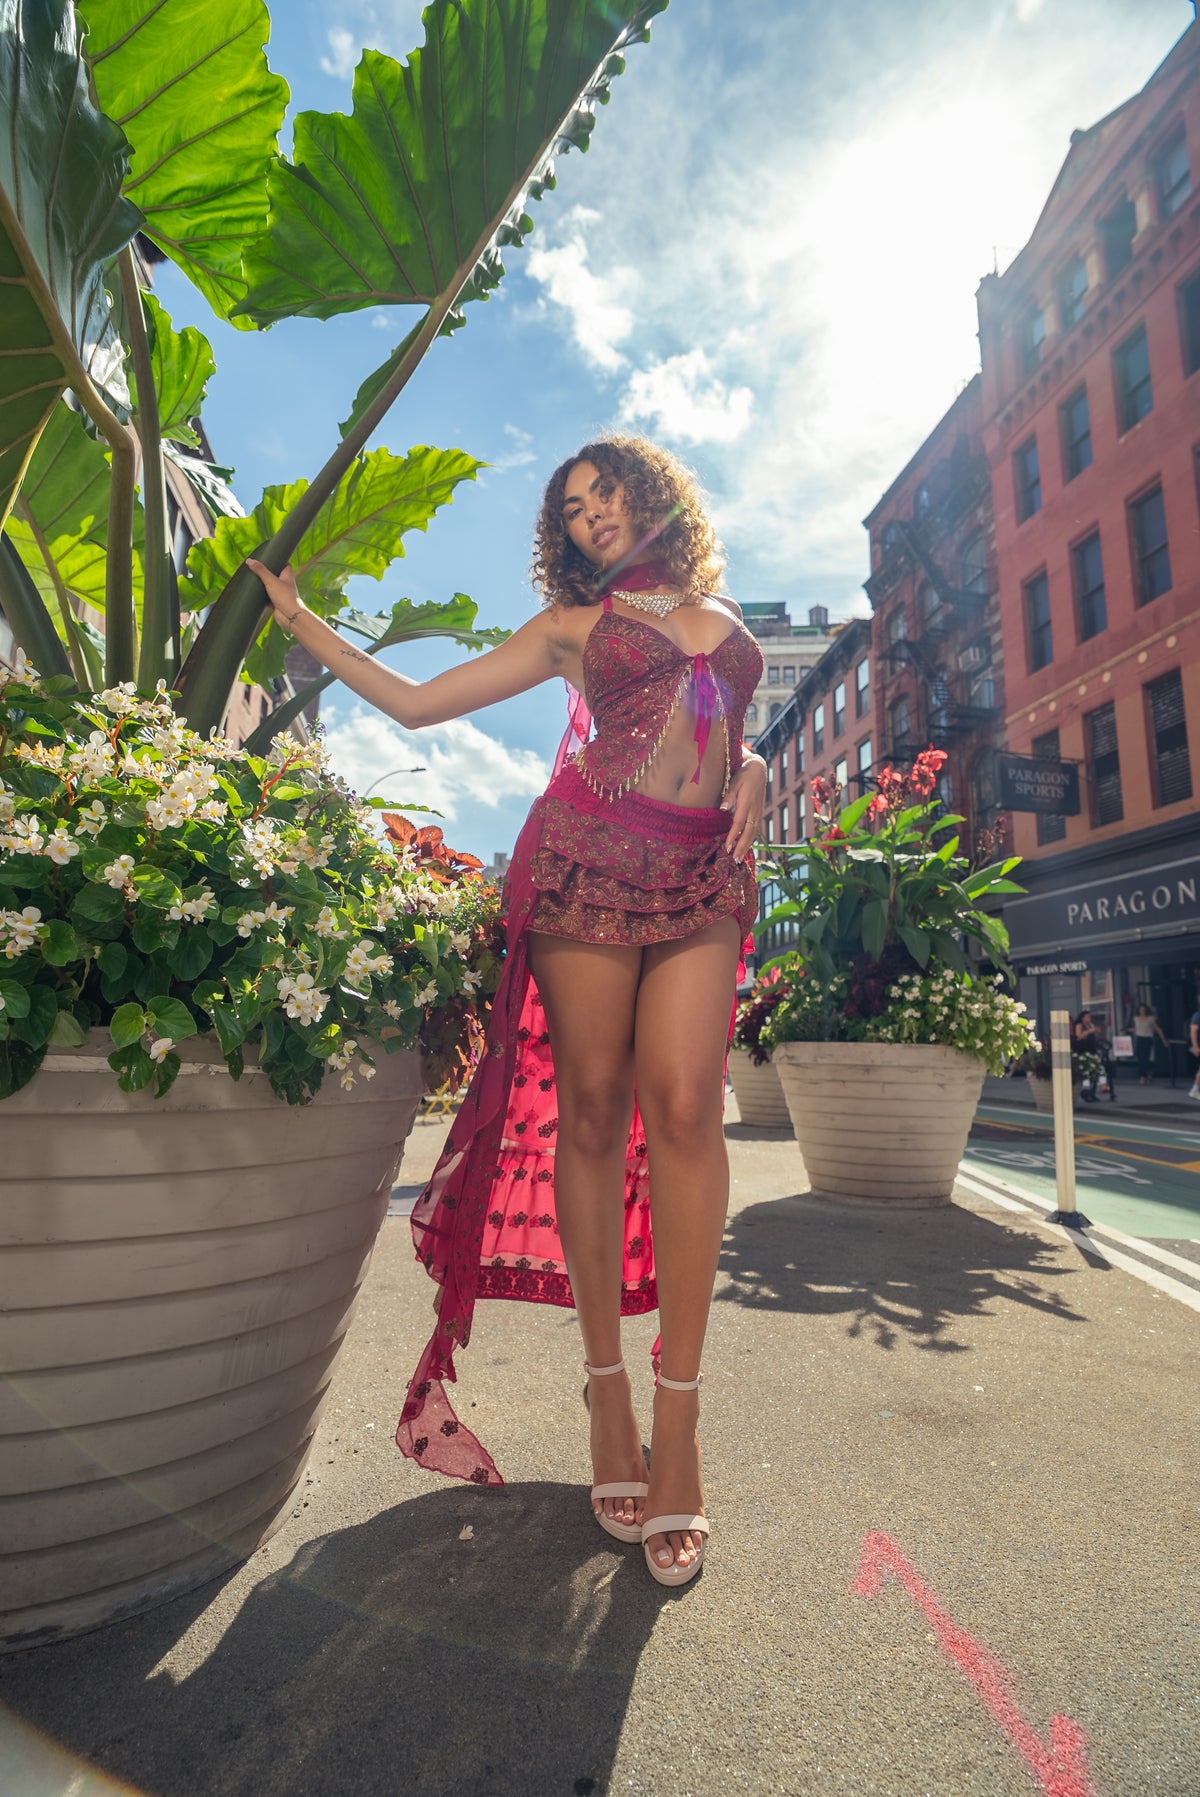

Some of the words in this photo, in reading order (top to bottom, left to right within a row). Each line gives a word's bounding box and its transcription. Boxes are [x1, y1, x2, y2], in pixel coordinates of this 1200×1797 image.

[1008, 768, 1070, 786] PARAGON
[1015, 783, 1065, 799] SPORTS
[1067, 878, 1196, 925] PARAGON
[1026, 964, 1058, 976] PARAGON
[1059, 960, 1087, 973] SPORTS
